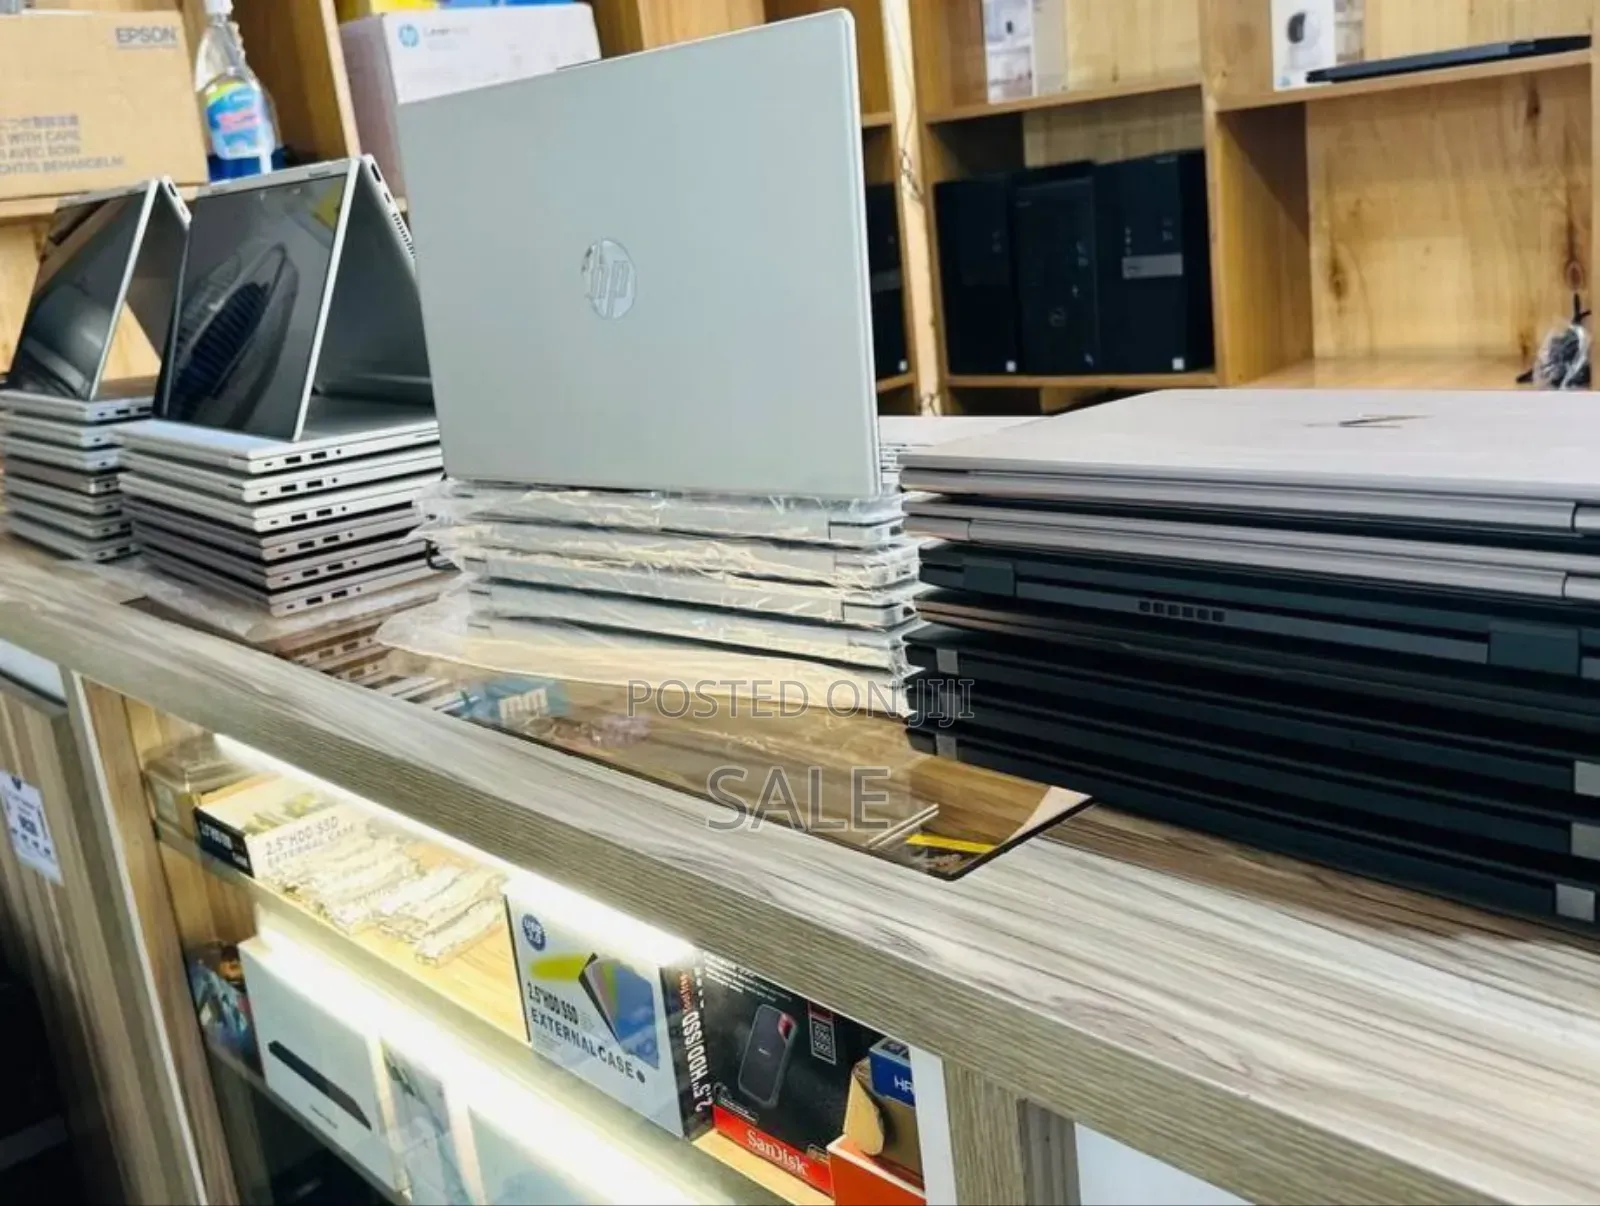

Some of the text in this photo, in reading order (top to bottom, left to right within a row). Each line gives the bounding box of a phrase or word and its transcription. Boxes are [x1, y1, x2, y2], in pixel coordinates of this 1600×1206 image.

[115, 26, 178, 43] EPSON
[586, 238, 635, 320] hp
[748, 1129, 810, 1177] SanDisk
